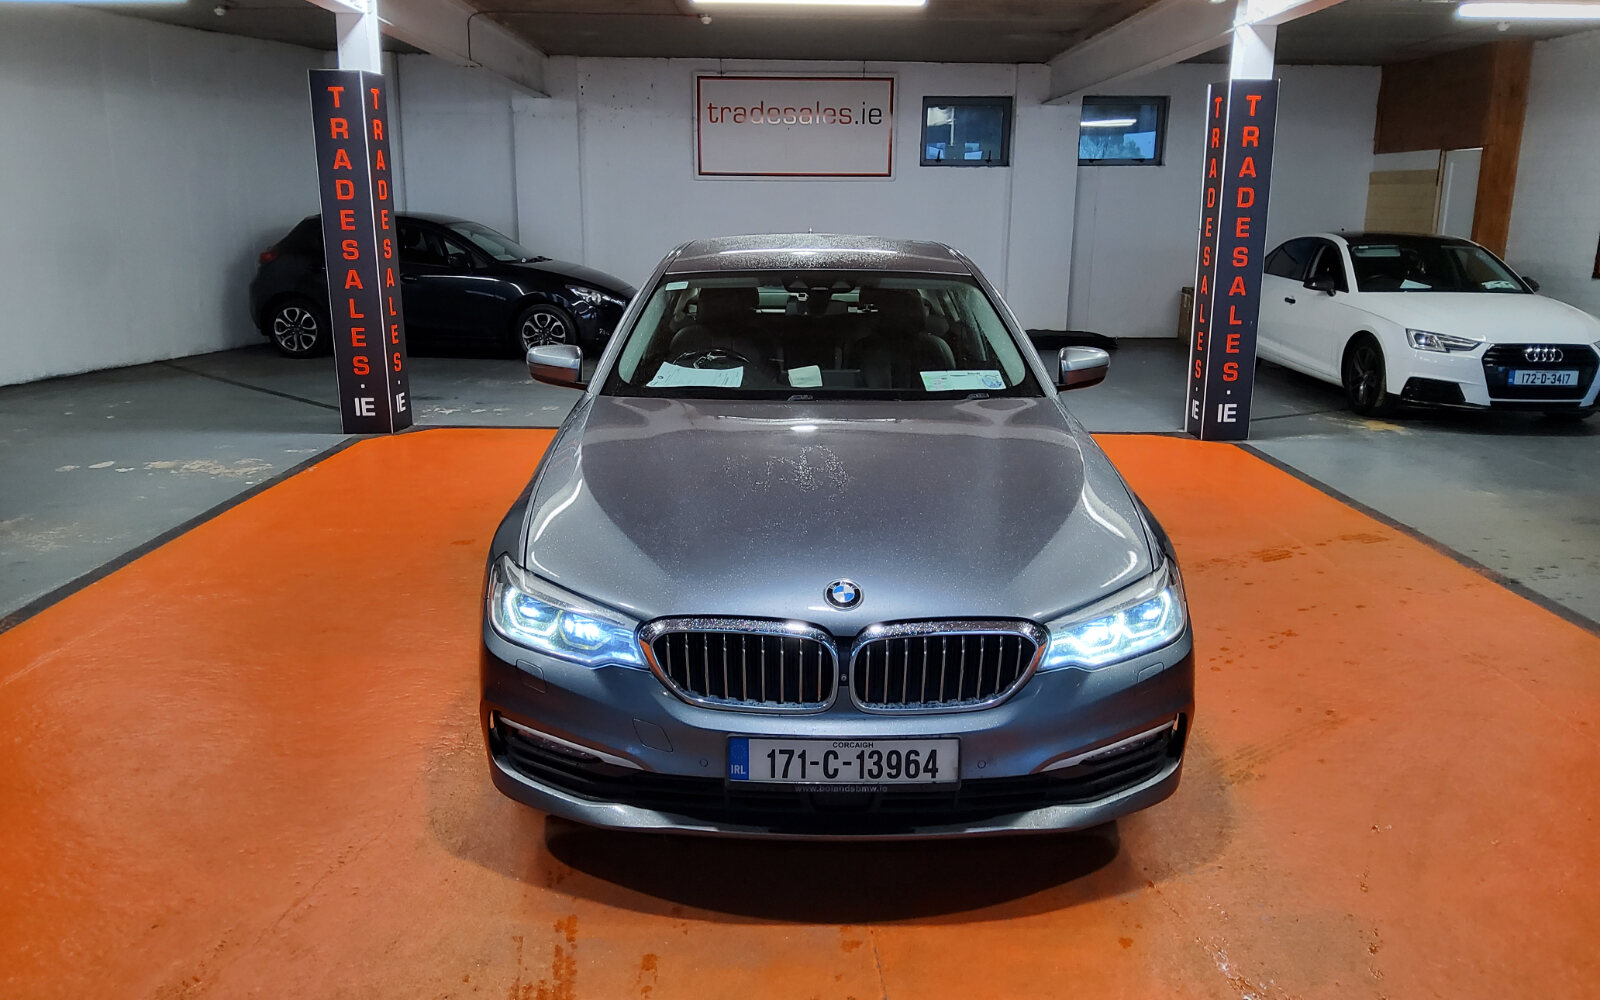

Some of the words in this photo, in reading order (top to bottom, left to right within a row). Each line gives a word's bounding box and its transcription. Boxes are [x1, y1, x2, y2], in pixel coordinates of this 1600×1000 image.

[707, 100, 882, 125] tradesales.ie
[1521, 373, 1571, 384] 172-D-3417
[832, 741, 874, 749] CORCAIGH
[767, 749, 939, 779] 171-C-13964
[730, 765, 746, 775] IRL
